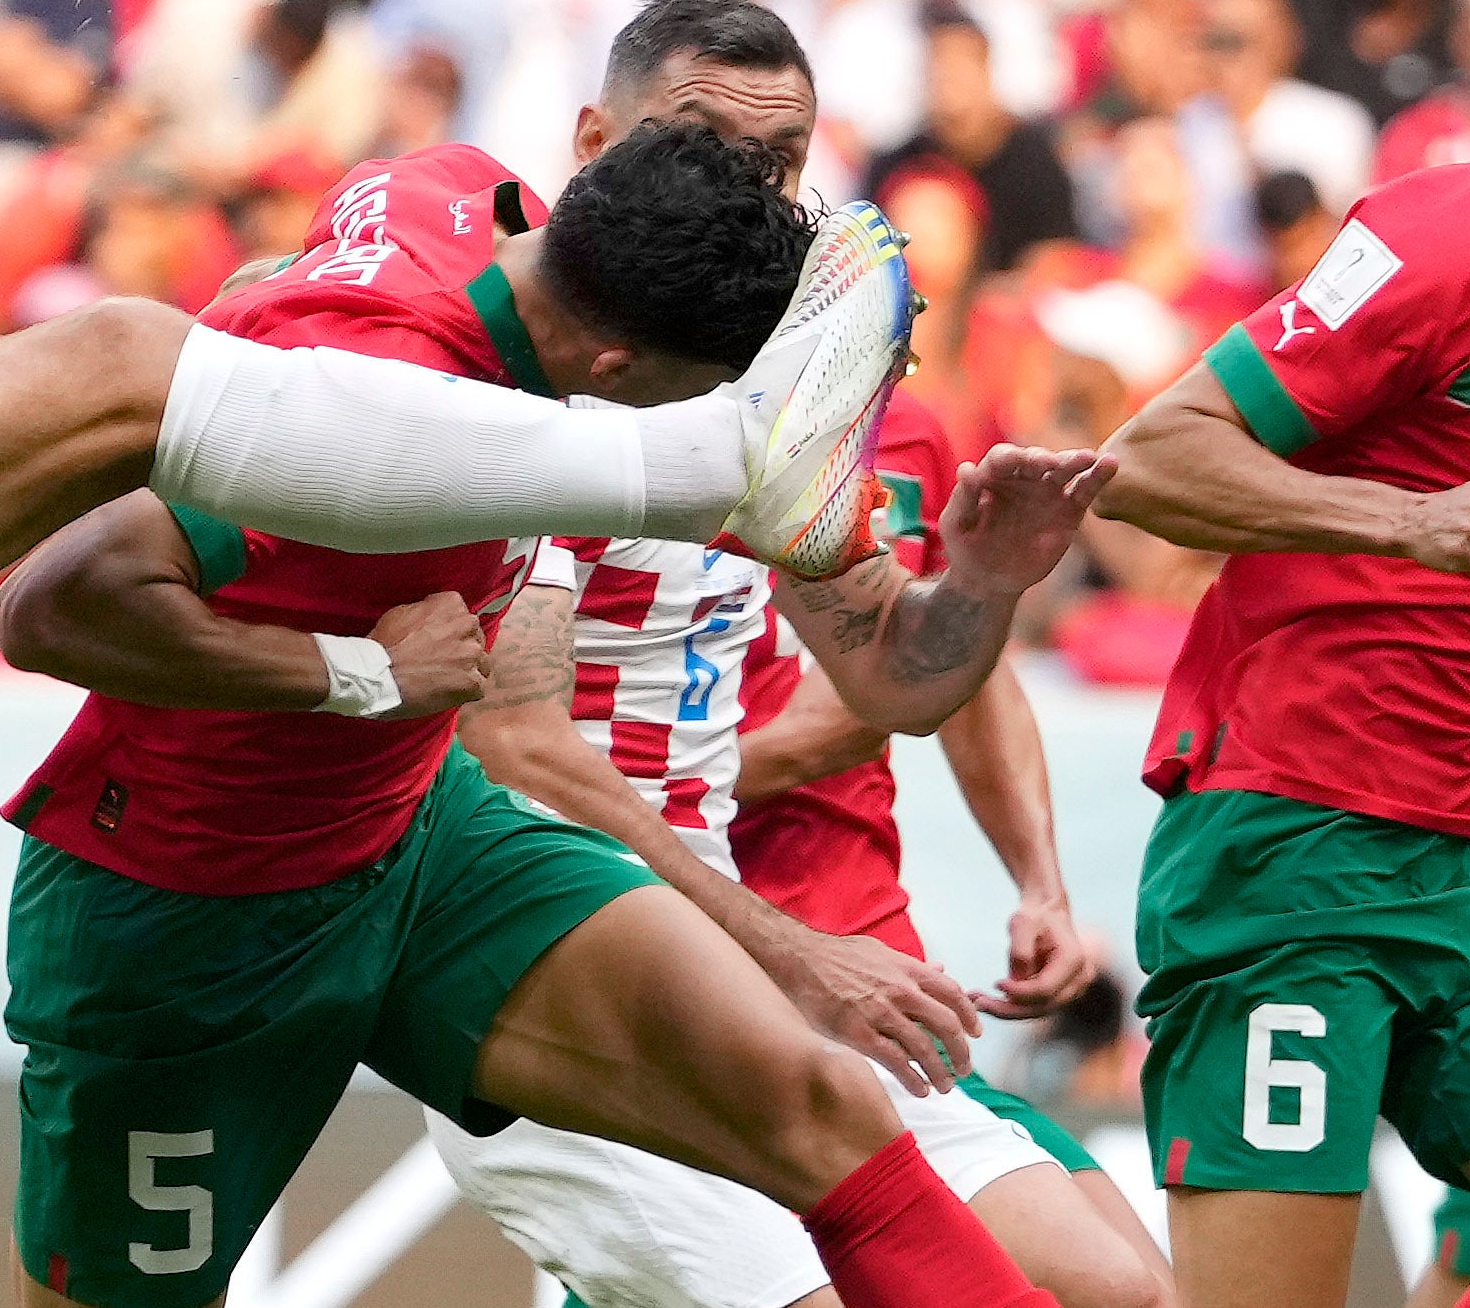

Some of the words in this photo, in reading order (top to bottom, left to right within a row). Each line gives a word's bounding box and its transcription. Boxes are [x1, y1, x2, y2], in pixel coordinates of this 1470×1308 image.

[677, 617, 732, 721] 6
[1242, 1003, 1327, 1152] 6
[127, 1128, 214, 1274] 5
